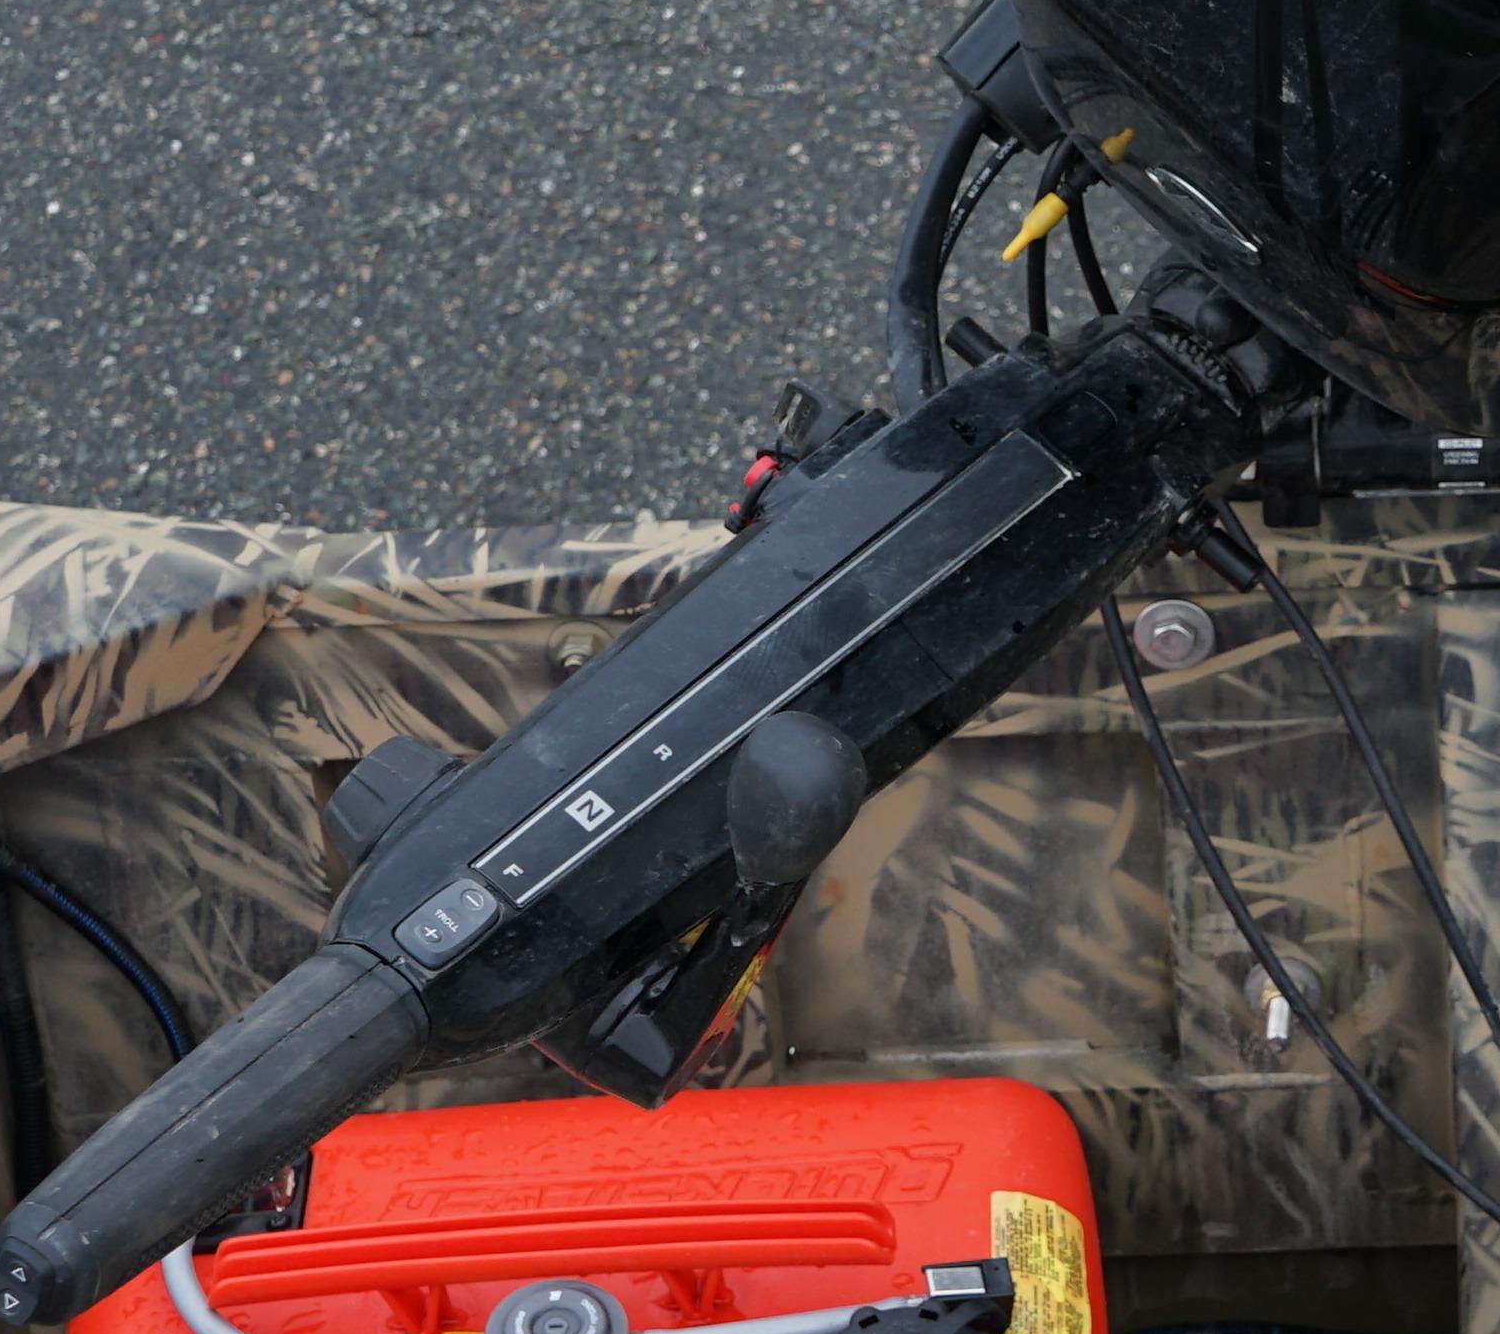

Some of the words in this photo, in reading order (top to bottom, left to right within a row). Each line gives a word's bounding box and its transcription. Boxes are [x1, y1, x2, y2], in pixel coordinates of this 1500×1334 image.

[653, 743, 673, 762] R
[502, 863, 524, 878] F
[434, 908, 460, 933] TROLL
